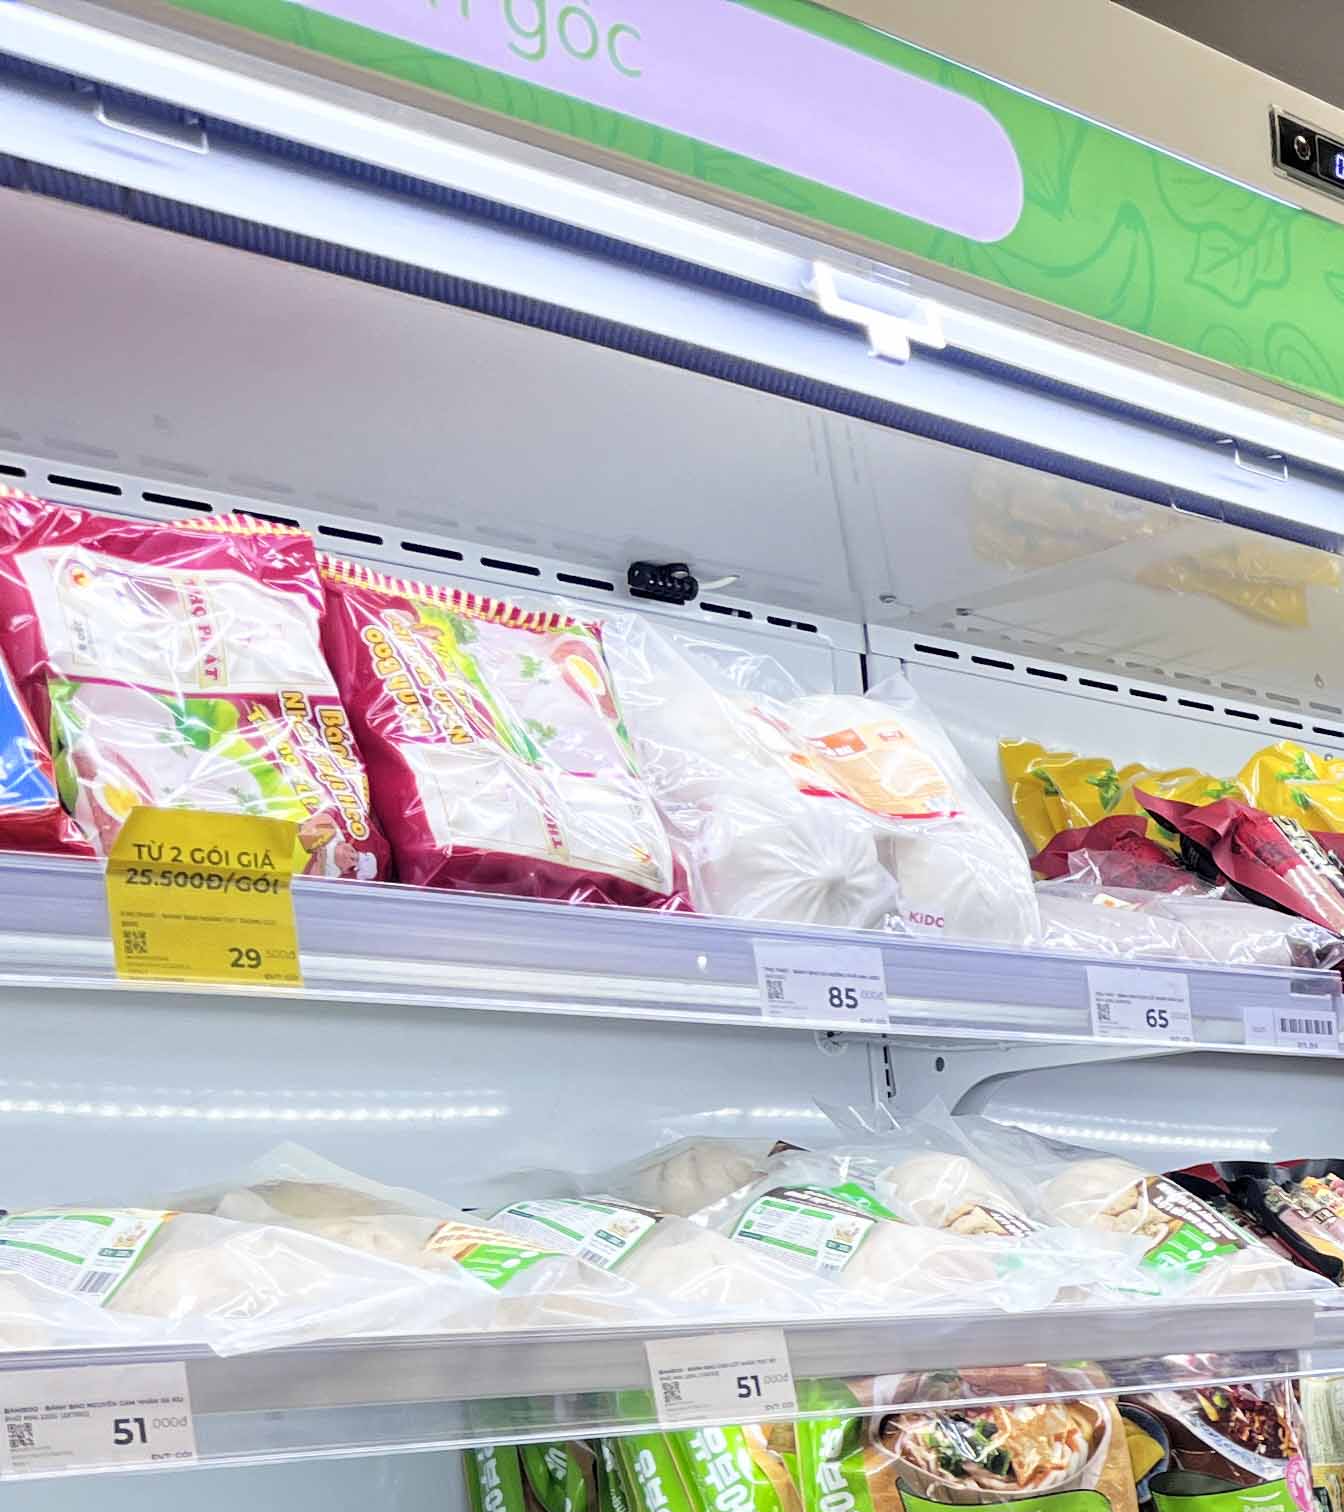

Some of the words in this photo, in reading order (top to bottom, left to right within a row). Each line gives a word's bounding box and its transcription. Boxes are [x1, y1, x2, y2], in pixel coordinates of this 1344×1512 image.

[134, 840, 163, 862] TỪ
[170, 847, 183, 863] 2
[190, 846, 230, 866] GÓI
[237, 849, 276, 869] GIÁ
[228, 947, 262, 969] 29
[828, 986, 859, 1009] 85
[1146, 1009, 1169, 1029] 65
[737, 1375, 762, 1398] 51
[113, 1417, 148, 1445] 51
